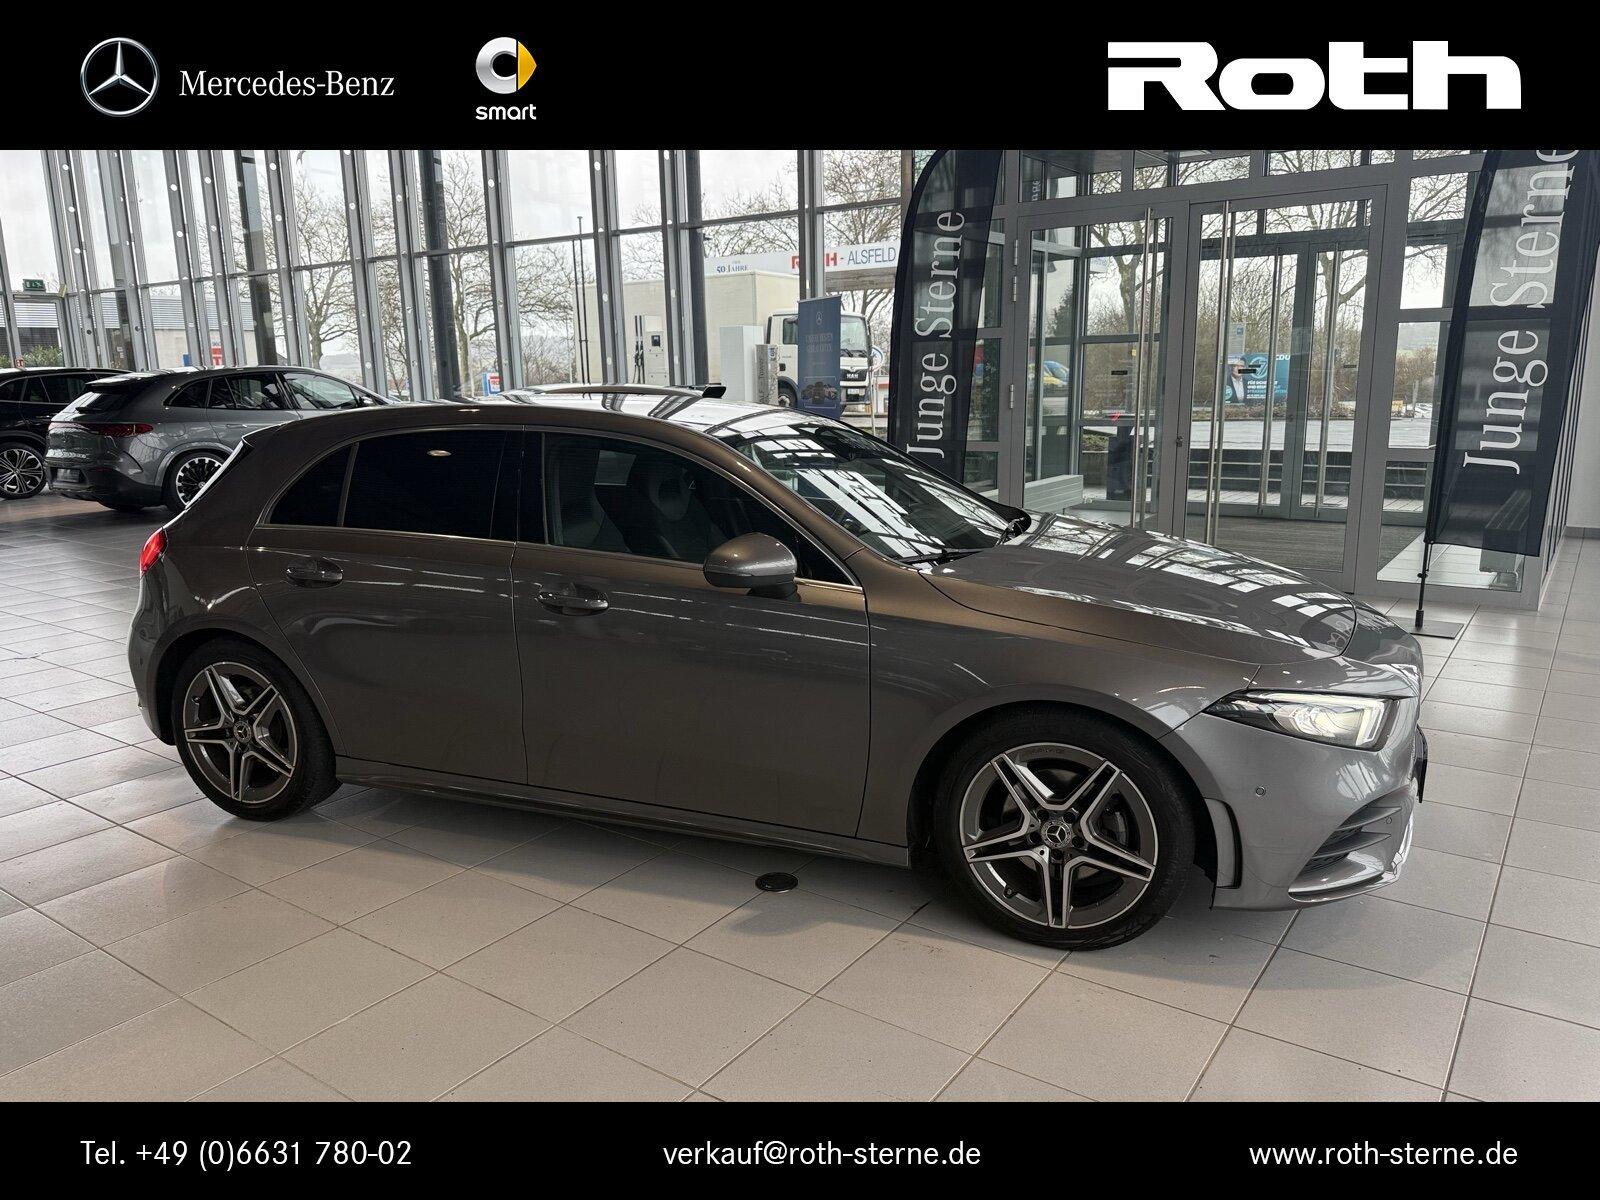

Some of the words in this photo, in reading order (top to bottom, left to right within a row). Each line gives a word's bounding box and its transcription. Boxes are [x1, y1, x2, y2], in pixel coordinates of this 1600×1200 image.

[848, 247, 897, 265] ALSFELD
[914, 211, 965, 338] Sterne
[907, 352, 957, 459] Junge
[1463, 330, 1548, 474] Junge
